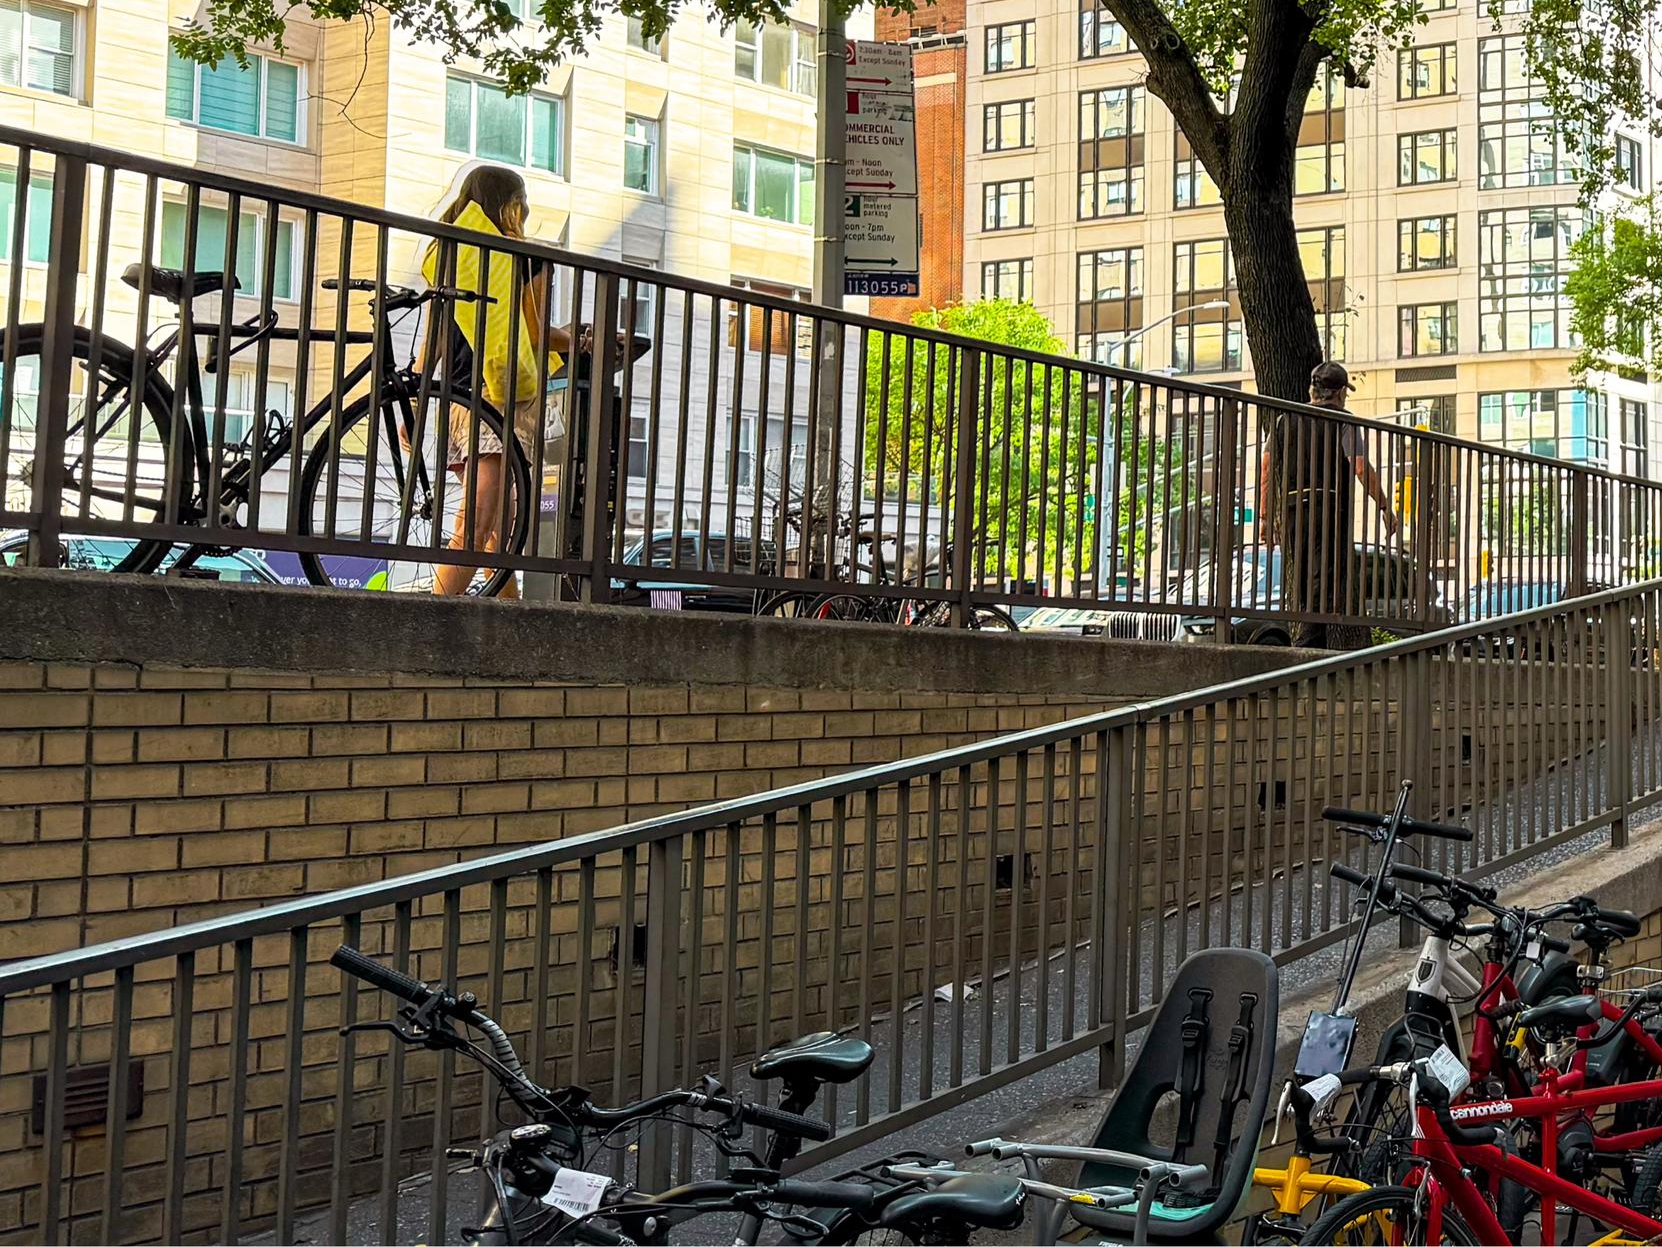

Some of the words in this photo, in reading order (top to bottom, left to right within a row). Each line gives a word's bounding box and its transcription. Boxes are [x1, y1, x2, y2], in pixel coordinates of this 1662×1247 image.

[846, 123, 895, 134] MMERCIAL
[847, 135, 879, 144] HICLES
[882, 136, 904, 146] ONLY
[862, 158, 882, 167] Noon
[863, 210, 889, 218] parking
[868, 223, 884, 232] 7pm
[868, 233, 895, 243] Sunday
[1450, 1101, 1513, 1120] cannondale
